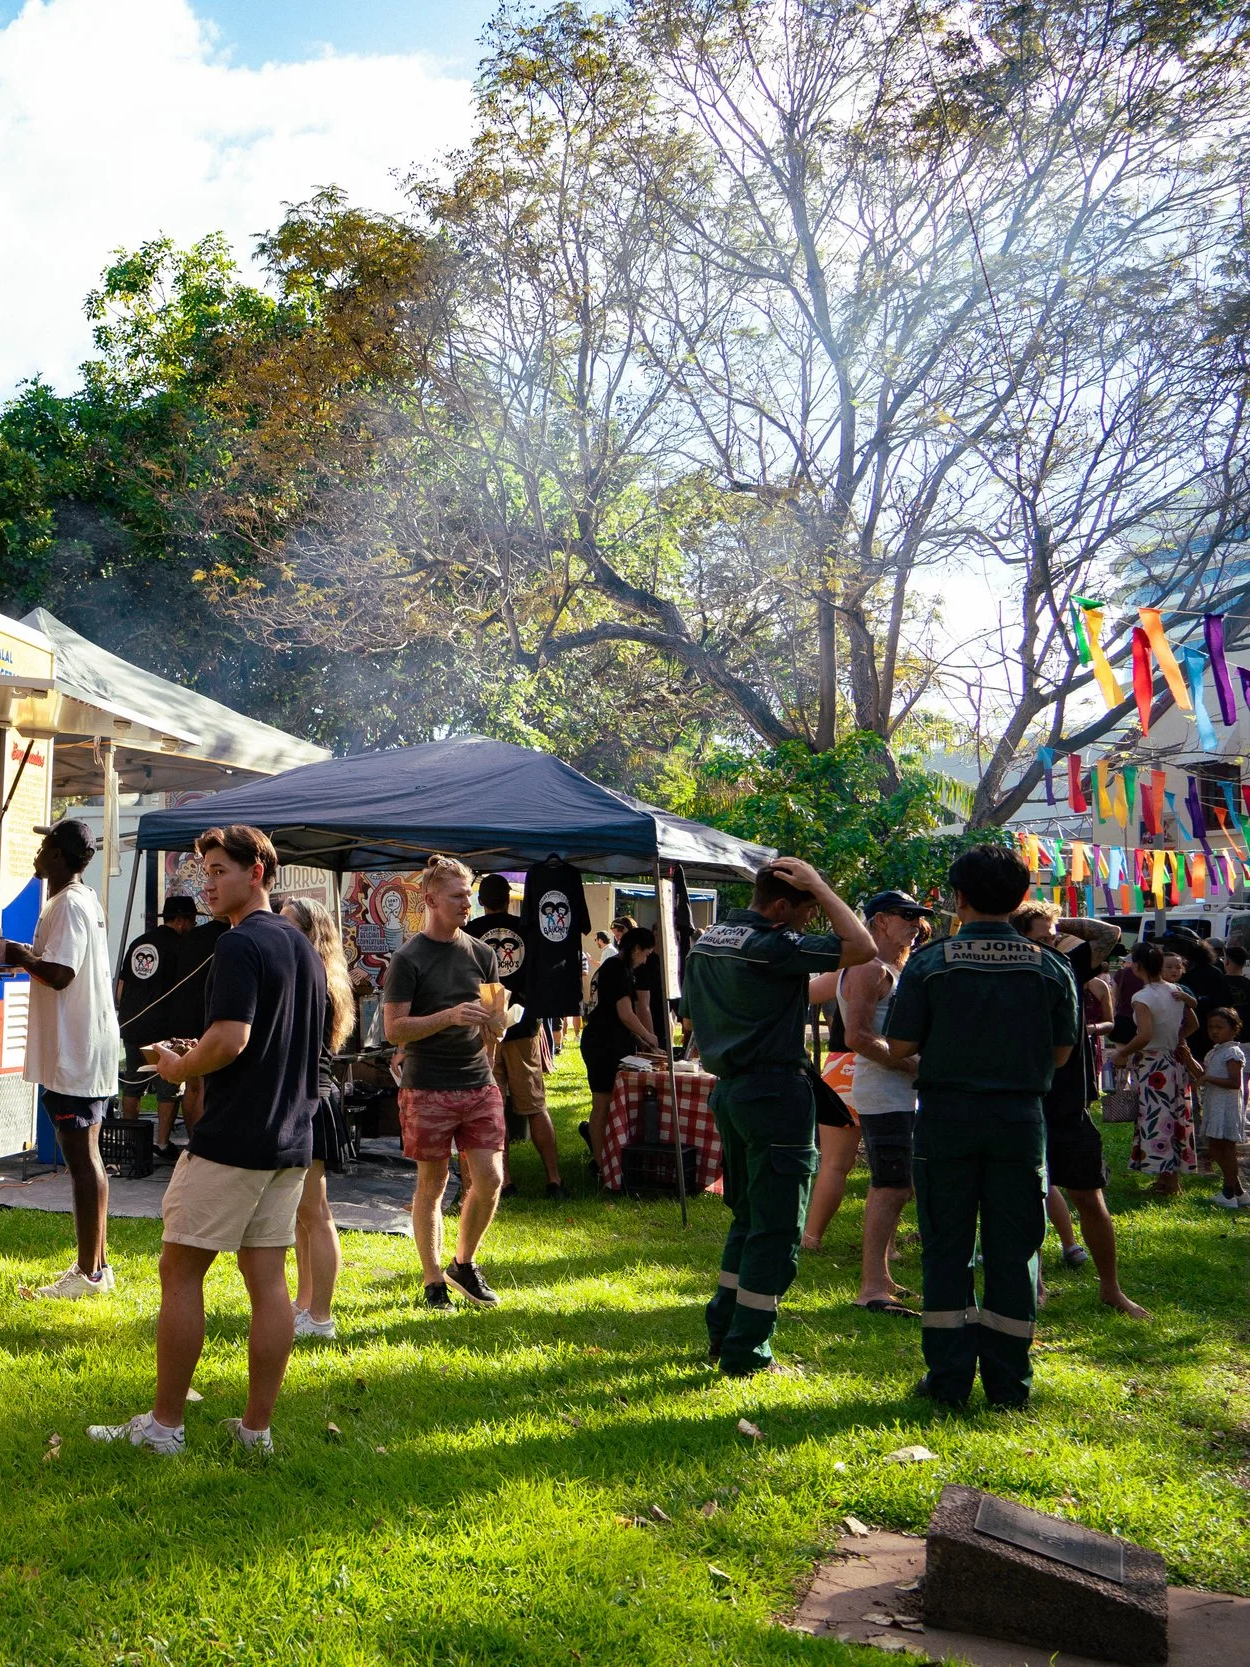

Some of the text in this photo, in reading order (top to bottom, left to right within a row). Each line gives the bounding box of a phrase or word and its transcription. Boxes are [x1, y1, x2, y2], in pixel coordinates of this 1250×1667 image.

[270, 866, 327, 892] HURROS
[717, 927, 747, 937] JOHN
[951, 942, 1036, 953] ST JOHN
[952, 952, 1036, 963] AMBULANCE
